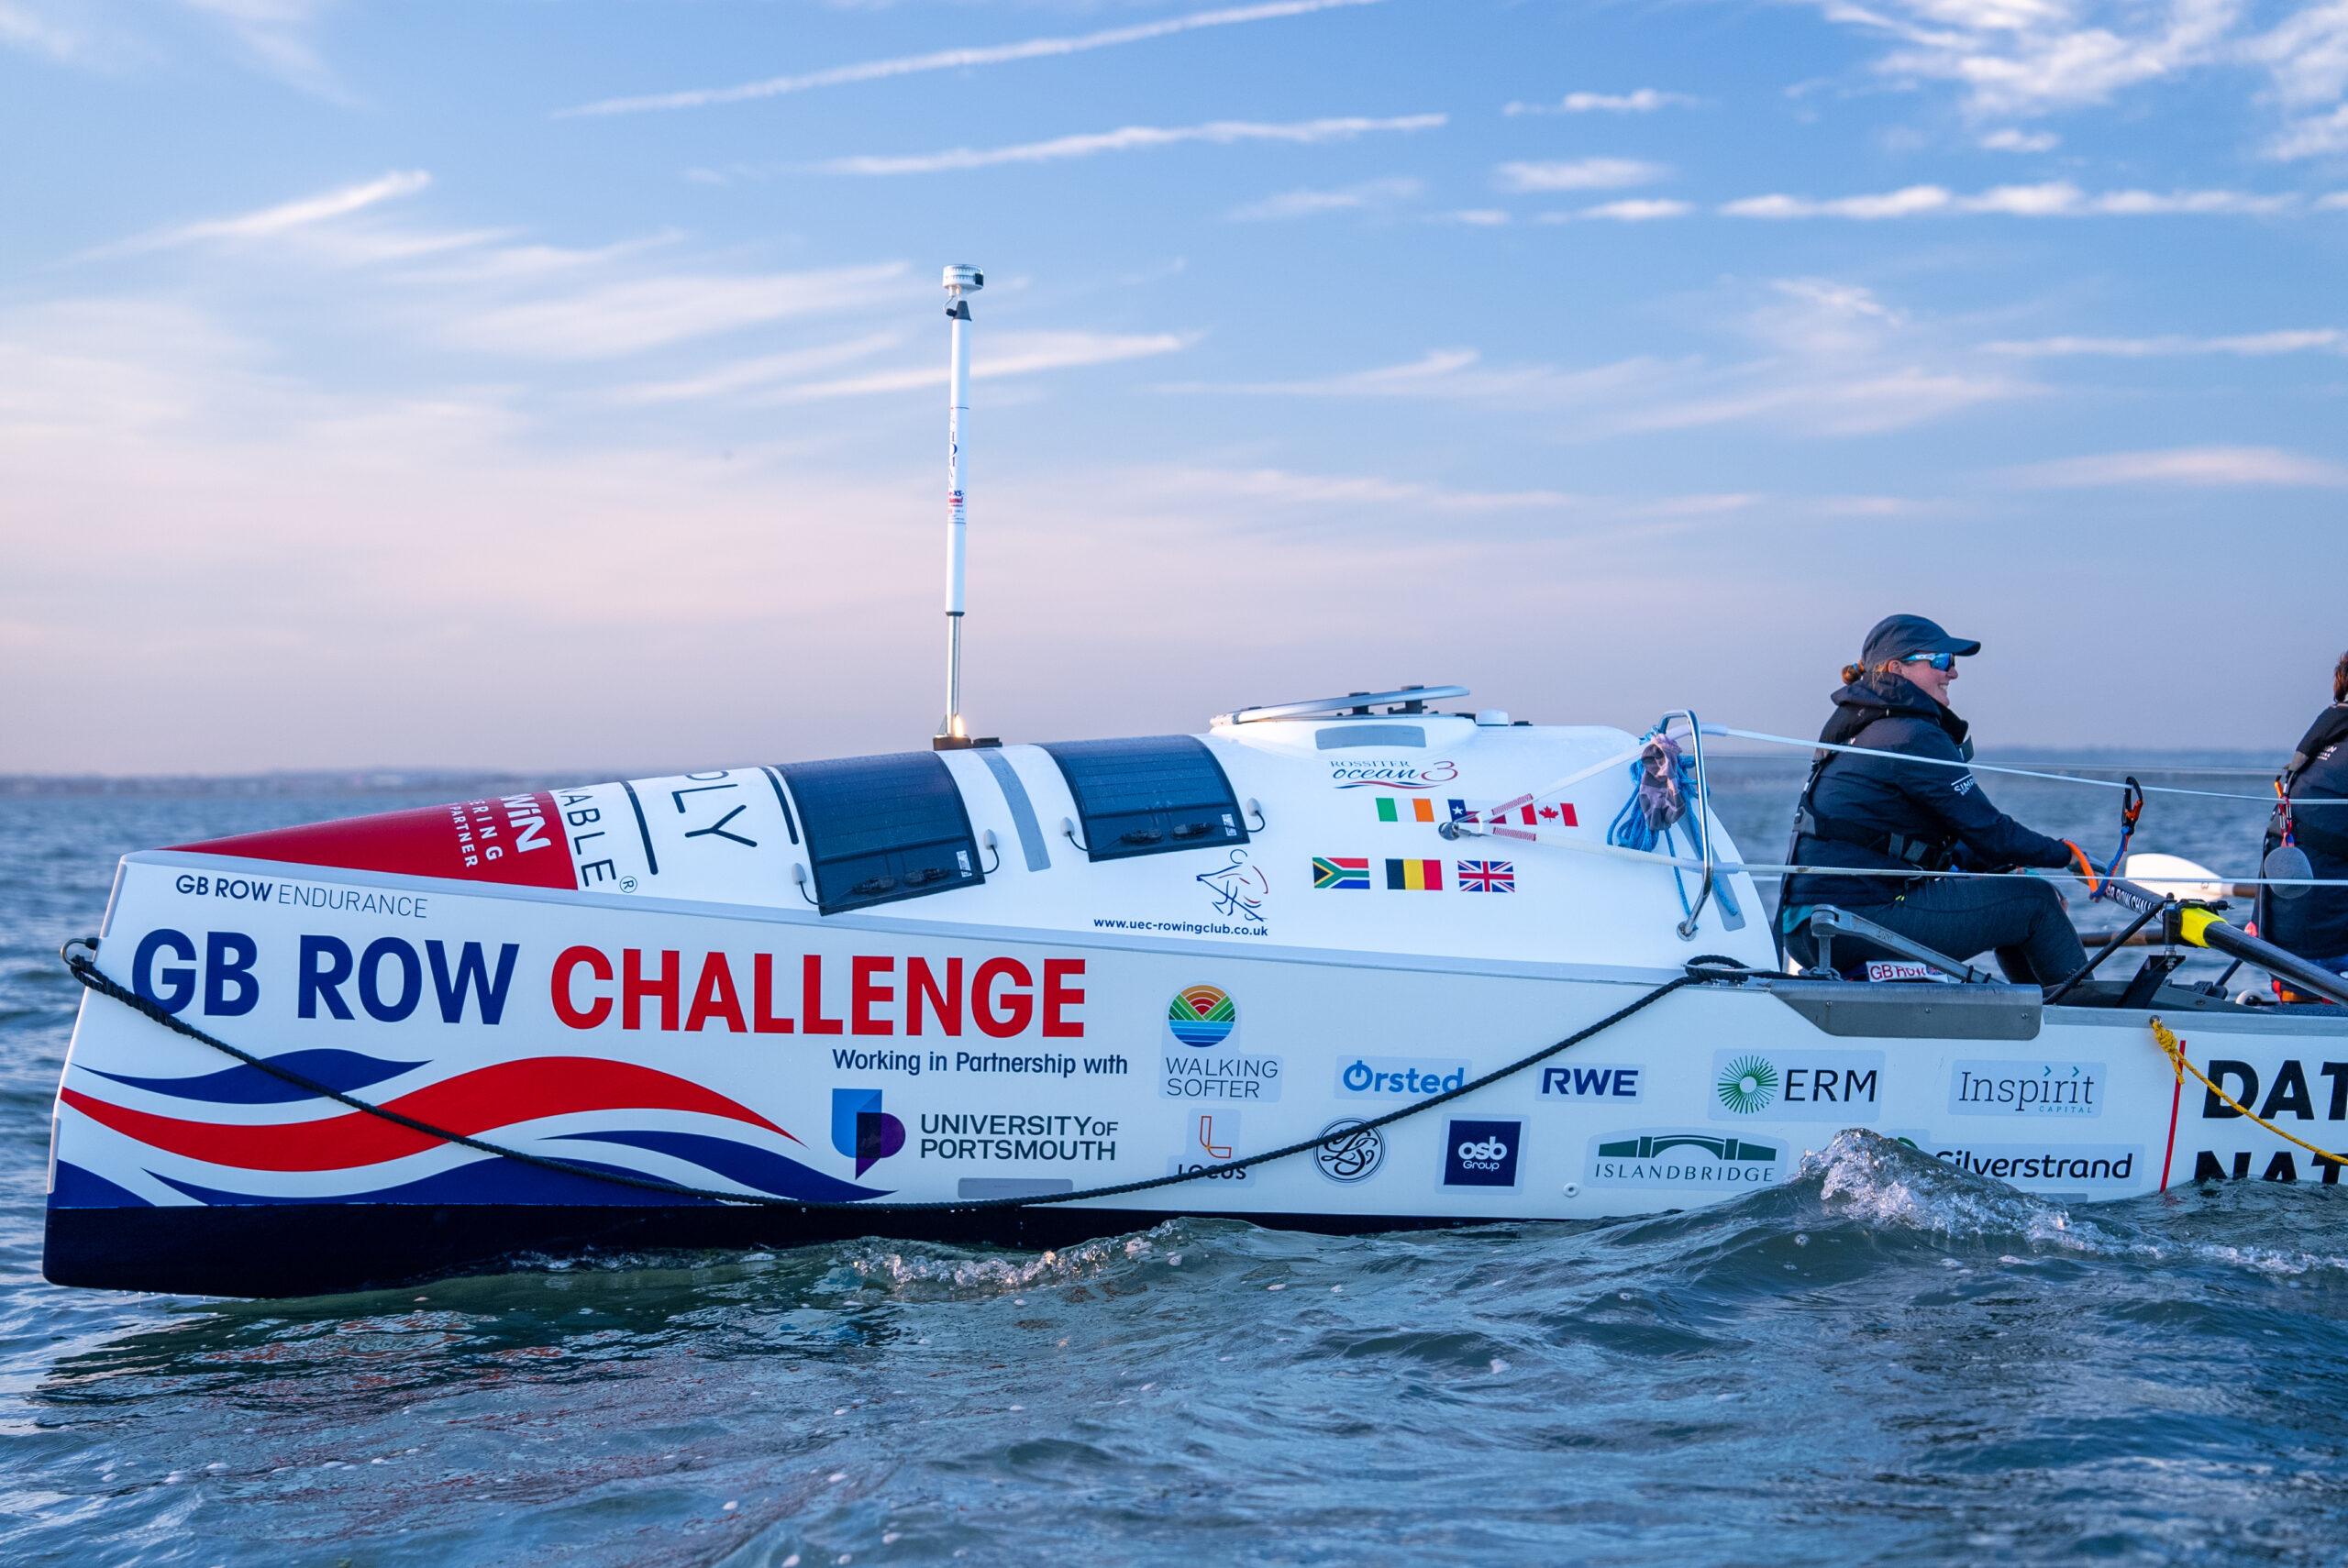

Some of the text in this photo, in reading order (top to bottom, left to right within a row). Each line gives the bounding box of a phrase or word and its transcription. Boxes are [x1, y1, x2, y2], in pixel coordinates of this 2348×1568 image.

[1330, 759, 1411, 768] ROSSITER
[1332, 760, 1459, 782] ocean 3
[175, 874, 429, 919] GB ROW ENDURANCE
[1093, 919, 1268, 937] www.uec-rowingclub.co.uk
[131, 928, 1086, 1039] GB ROW CHALLENGE
[1870, 964, 1894, 980] GB
[832, 1049, 1129, 1078] Working in Partnership with
[1166, 1056, 1279, 1078] WALKING
[1166, 1077, 1261, 1099] SOFTER
[1541, 1067, 1640, 1097] RWE
[1784, 1068, 1878, 1102] ERM
[1958, 1066, 2095, 1112] Inspirit
[2202, 1059, 2348, 1121] DAT
[2039, 1106, 2093, 1114] CAPITAL
[920, 1113, 1119, 1137] UNIVERSITY OF
[920, 1138, 1116, 1161] PORTSMOUTH
[1458, 1136, 1508, 1161] osb
[1463, 1160, 1500, 1172] Group
[1595, 1163, 1776, 1182] ISLANDBRIDGE
